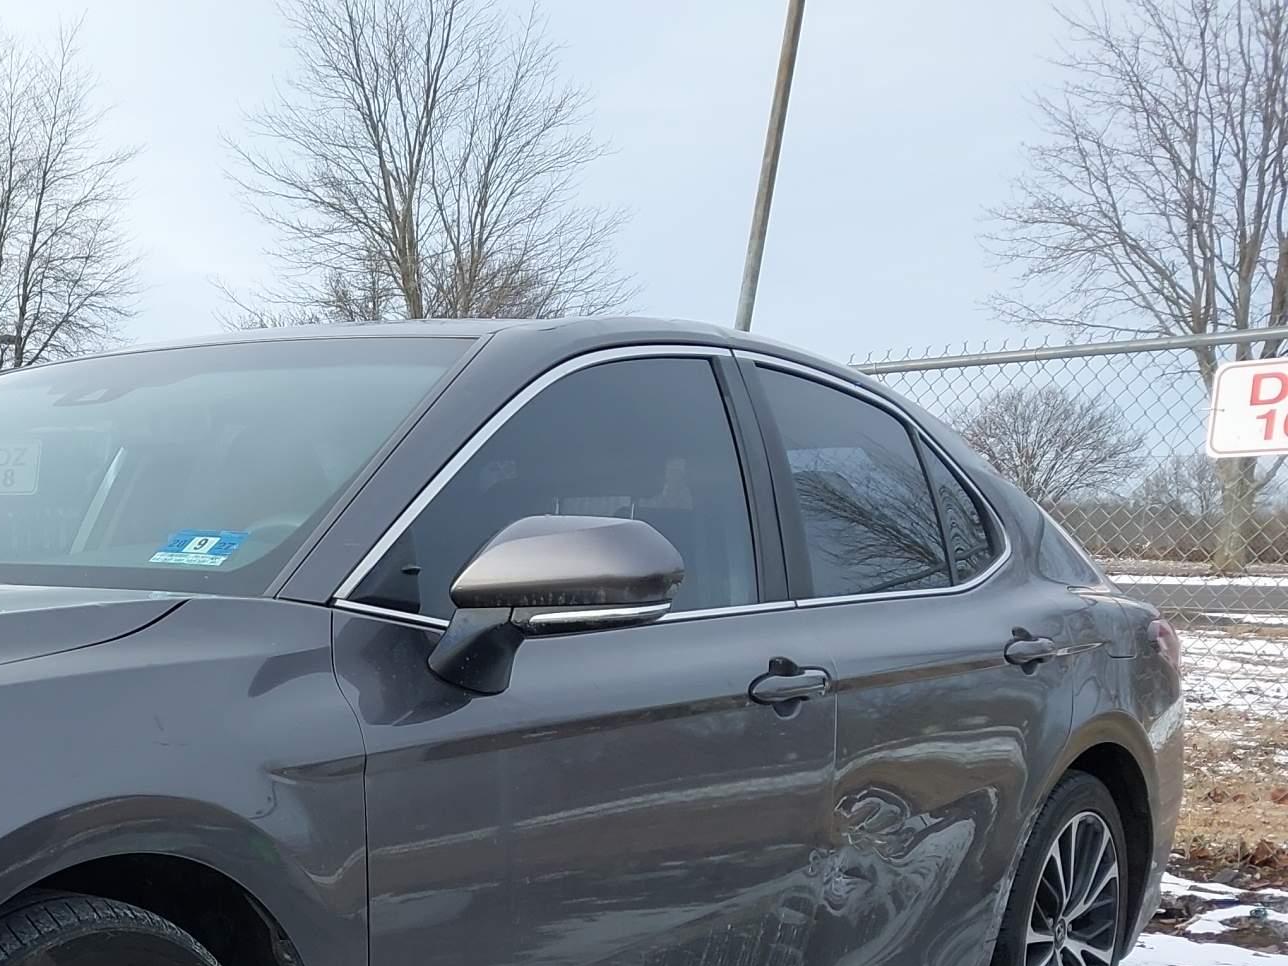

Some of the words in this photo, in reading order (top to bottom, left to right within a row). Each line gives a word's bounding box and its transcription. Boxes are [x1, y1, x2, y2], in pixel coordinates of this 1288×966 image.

[1256, 409, 1288, 440] 1
[2, 469, 16, 488] 8
[193, 538, 209, 550] 9
